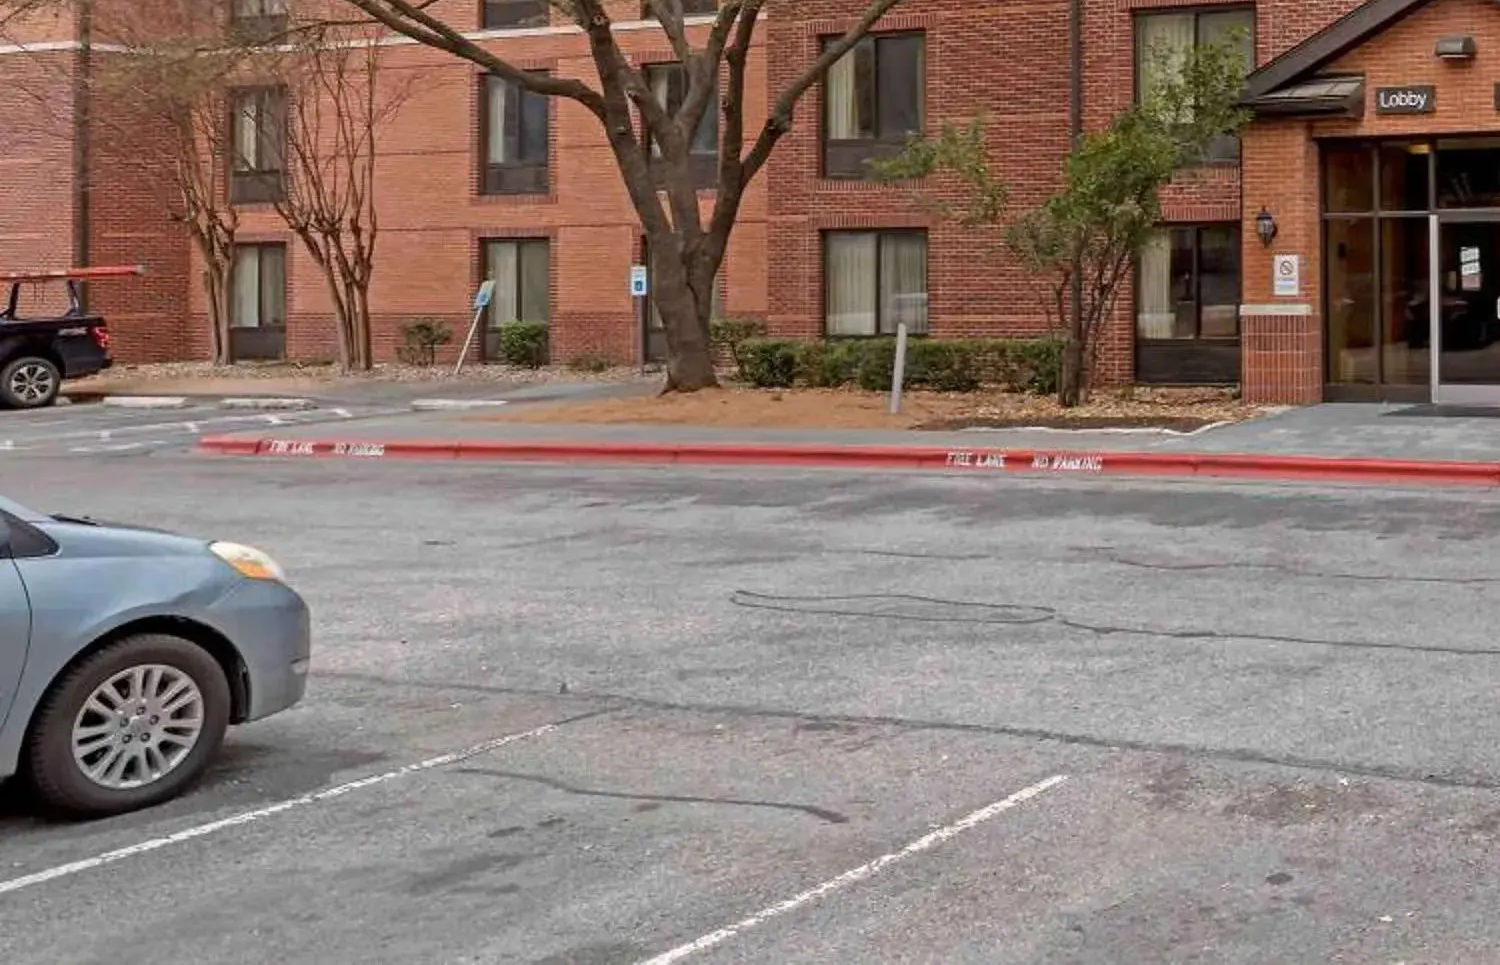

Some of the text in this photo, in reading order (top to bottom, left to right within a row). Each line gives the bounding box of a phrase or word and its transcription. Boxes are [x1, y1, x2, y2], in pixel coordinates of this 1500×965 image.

[1379, 90, 1427, 109] Lobby
[946, 452, 1103, 471] FIRE LANE NO PARKING
